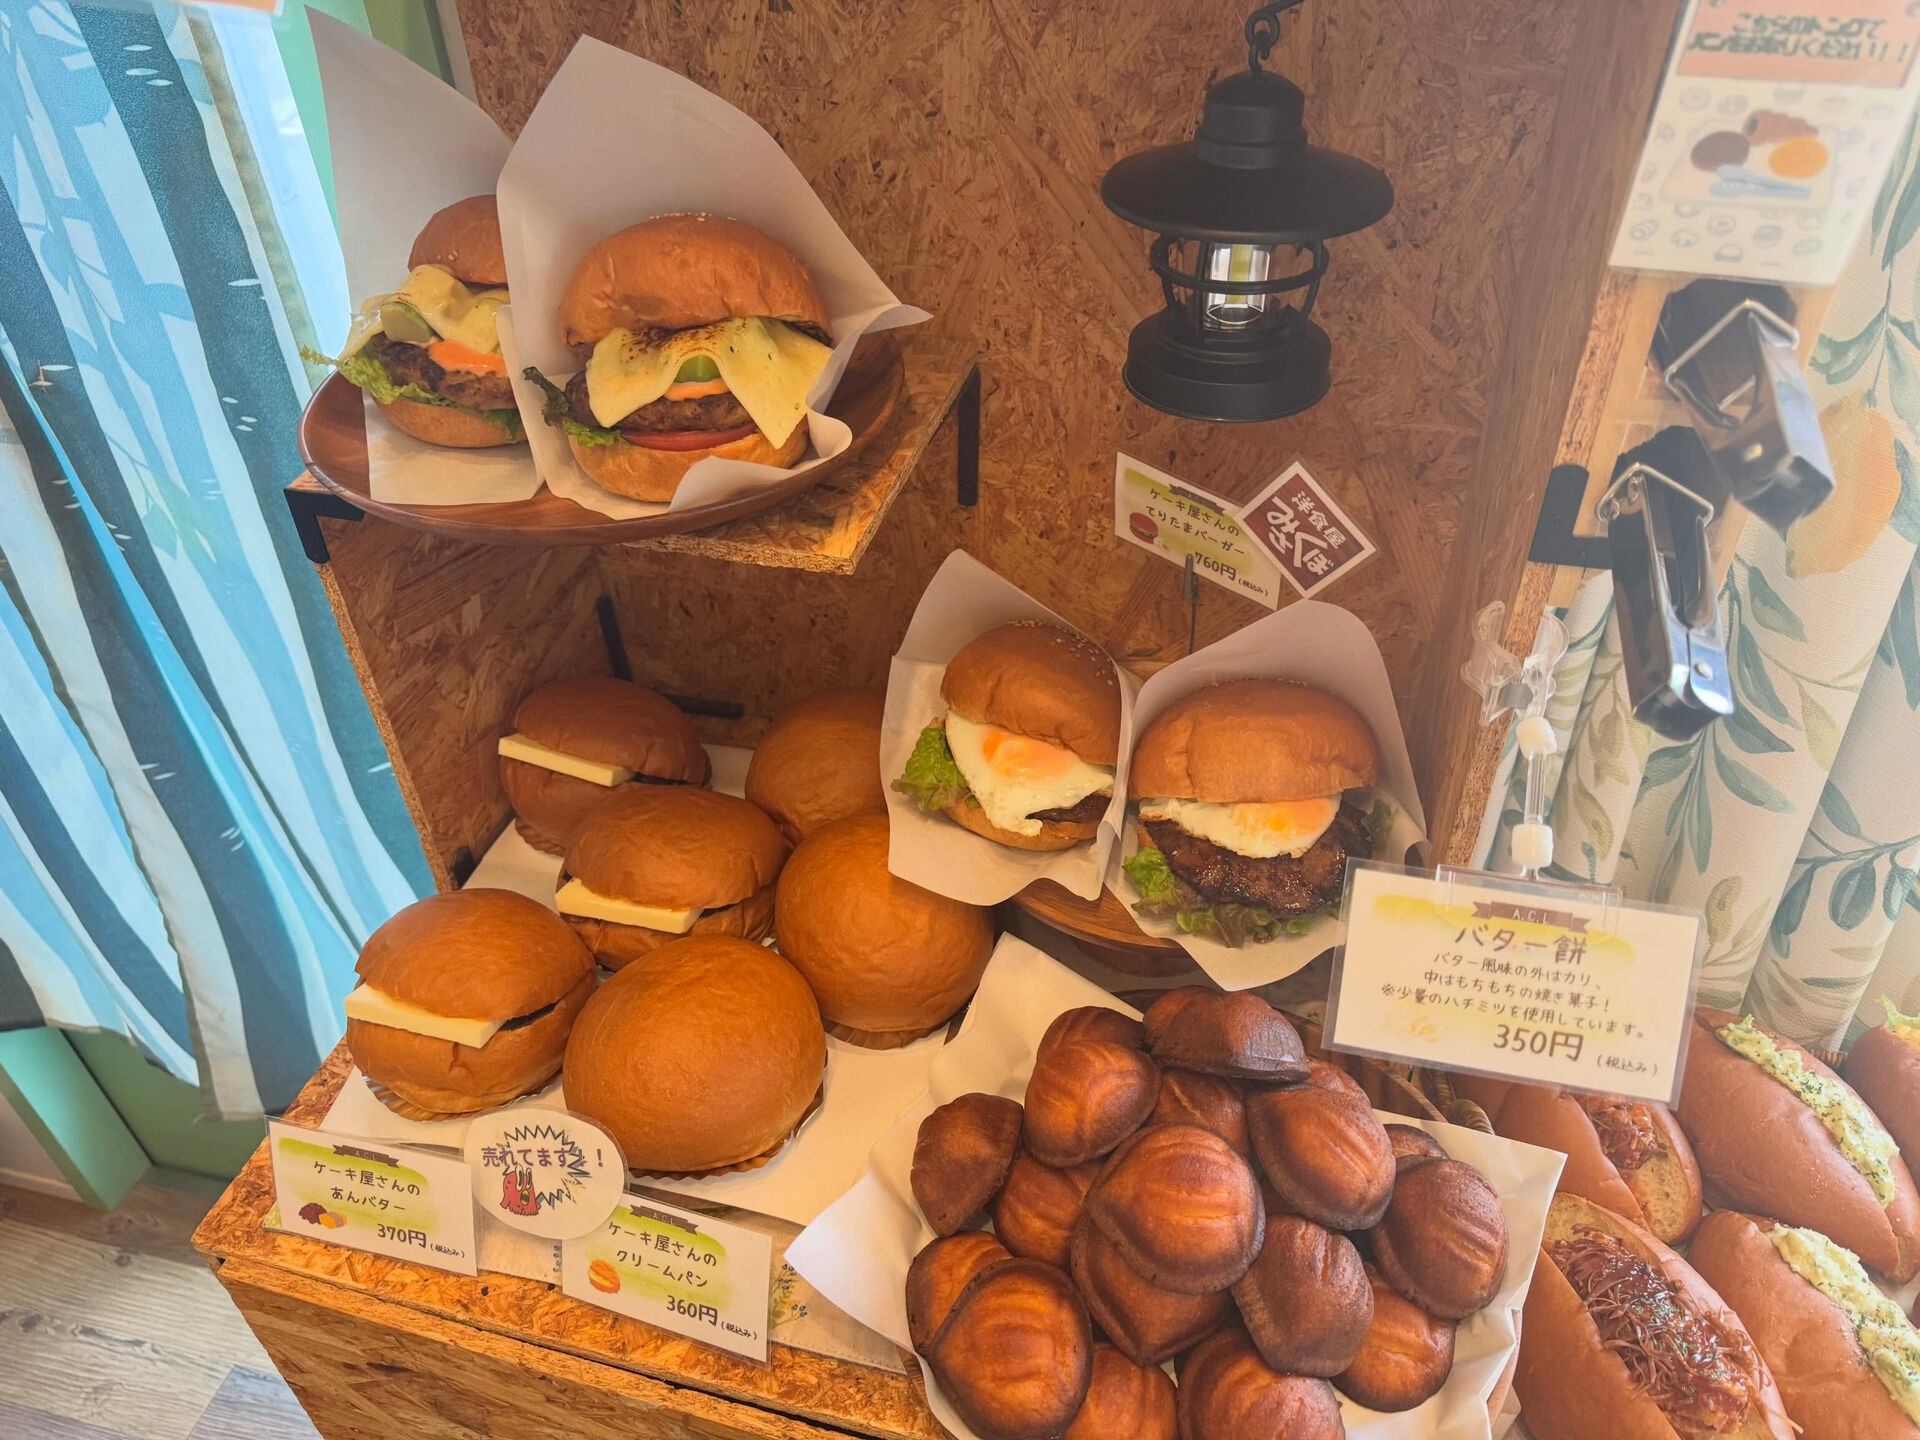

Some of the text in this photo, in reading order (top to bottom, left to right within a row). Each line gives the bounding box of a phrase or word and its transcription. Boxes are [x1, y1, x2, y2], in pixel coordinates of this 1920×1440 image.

[1146, 505, 1244, 554] てりたまバーガー
[1150, 488, 1239, 536] ケーキ屋さんの
[1291, 491, 1346, 549] 洋食屋
[1194, 551, 1236, 581] 760円
[1455, 924, 1588, 965] バター餅
[1434, 952, 1601, 990] バター風味の外はカリ、
[1424, 970, 1610, 1012] 中はもちもちの焼き菓子！
[1381, 983, 1644, 1039] ※少量のハチミツを使用しています。
[1493, 1024, 1584, 1062] 350円
[313, 1161, 420, 1196] ケーキ屋さんの
[330, 1187, 405, 1211] あんバター
[377, 1223, 427, 1248] 370円
[608, 1221, 716, 1267] ケーキ屋さんの
[616, 1250, 708, 1288] クリームパン
[666, 1295, 718, 1326] 360円
